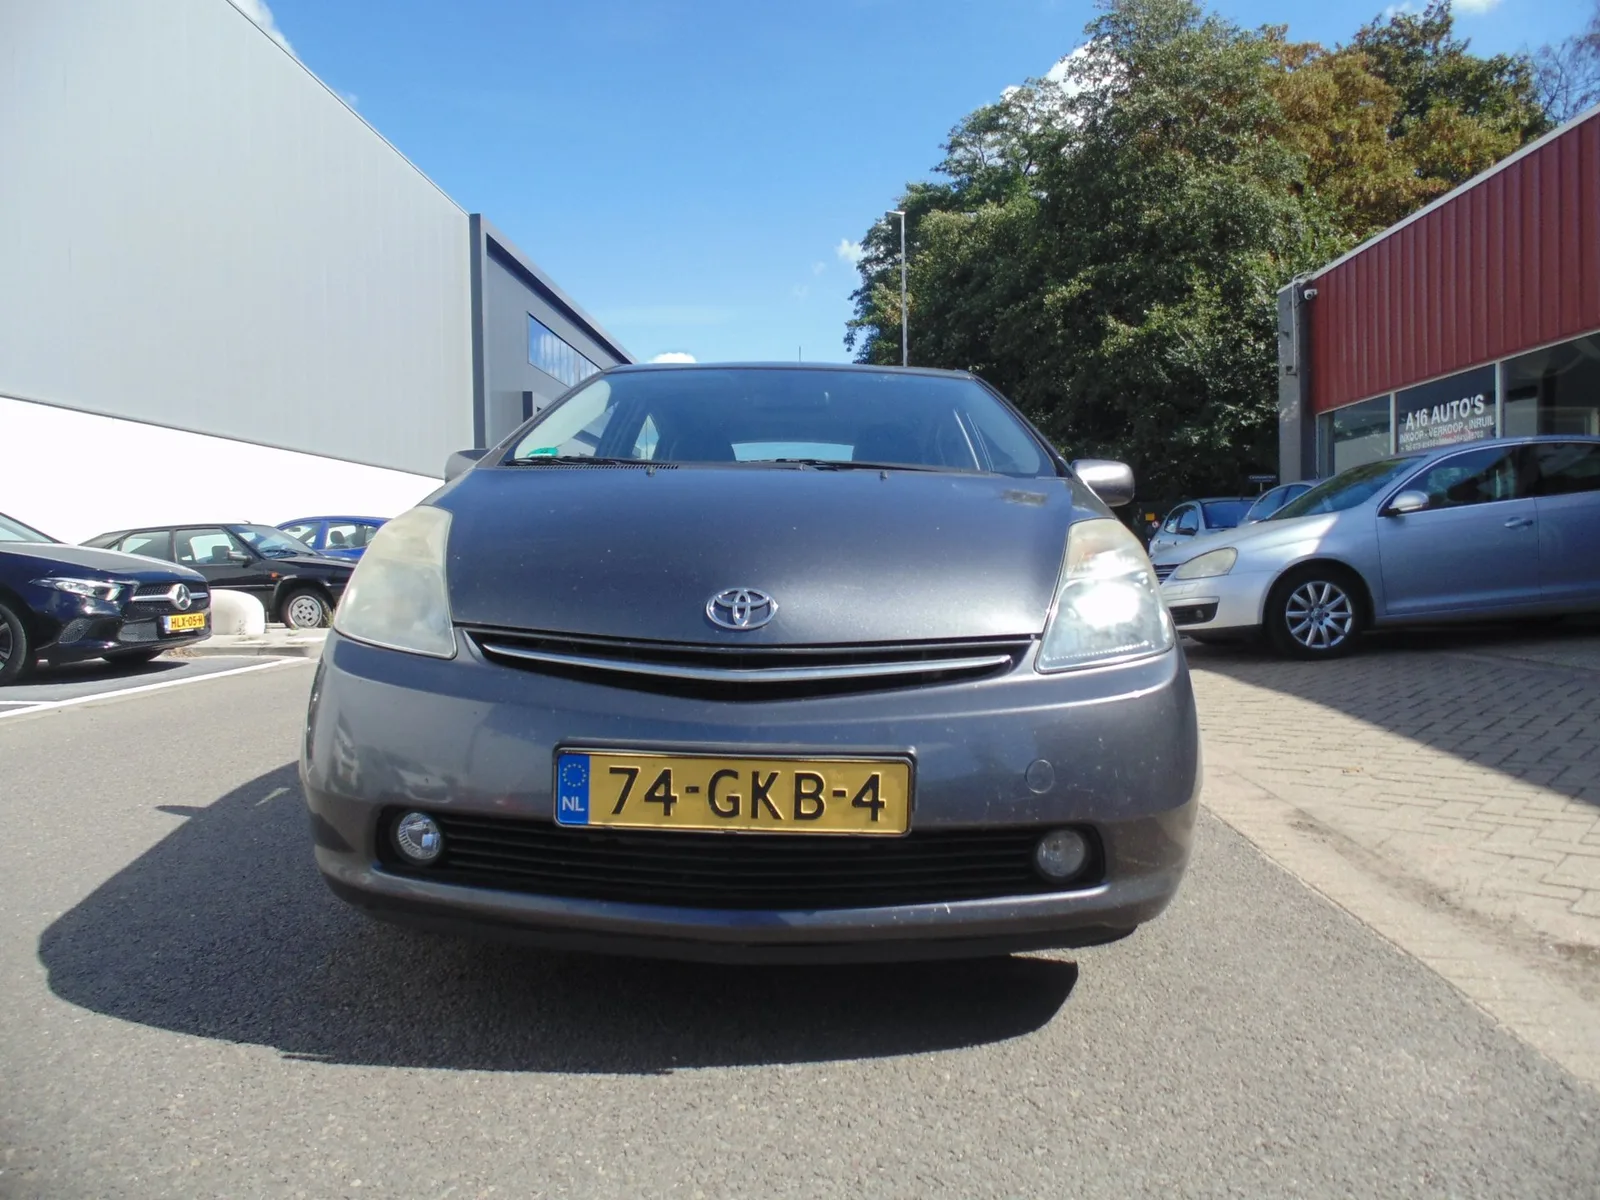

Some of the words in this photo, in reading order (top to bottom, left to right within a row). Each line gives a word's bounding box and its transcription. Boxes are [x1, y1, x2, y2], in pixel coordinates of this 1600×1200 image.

[1405, 409, 1428, 430] A16
[1431, 394, 1484, 424] AUTO'S
[1429, 422, 1463, 437] VERKOOP
[1468, 416, 1494, 429] INRUIL
[562, 797, 584, 811] NL
[609, 767, 885, 822] 74-GKB-4
